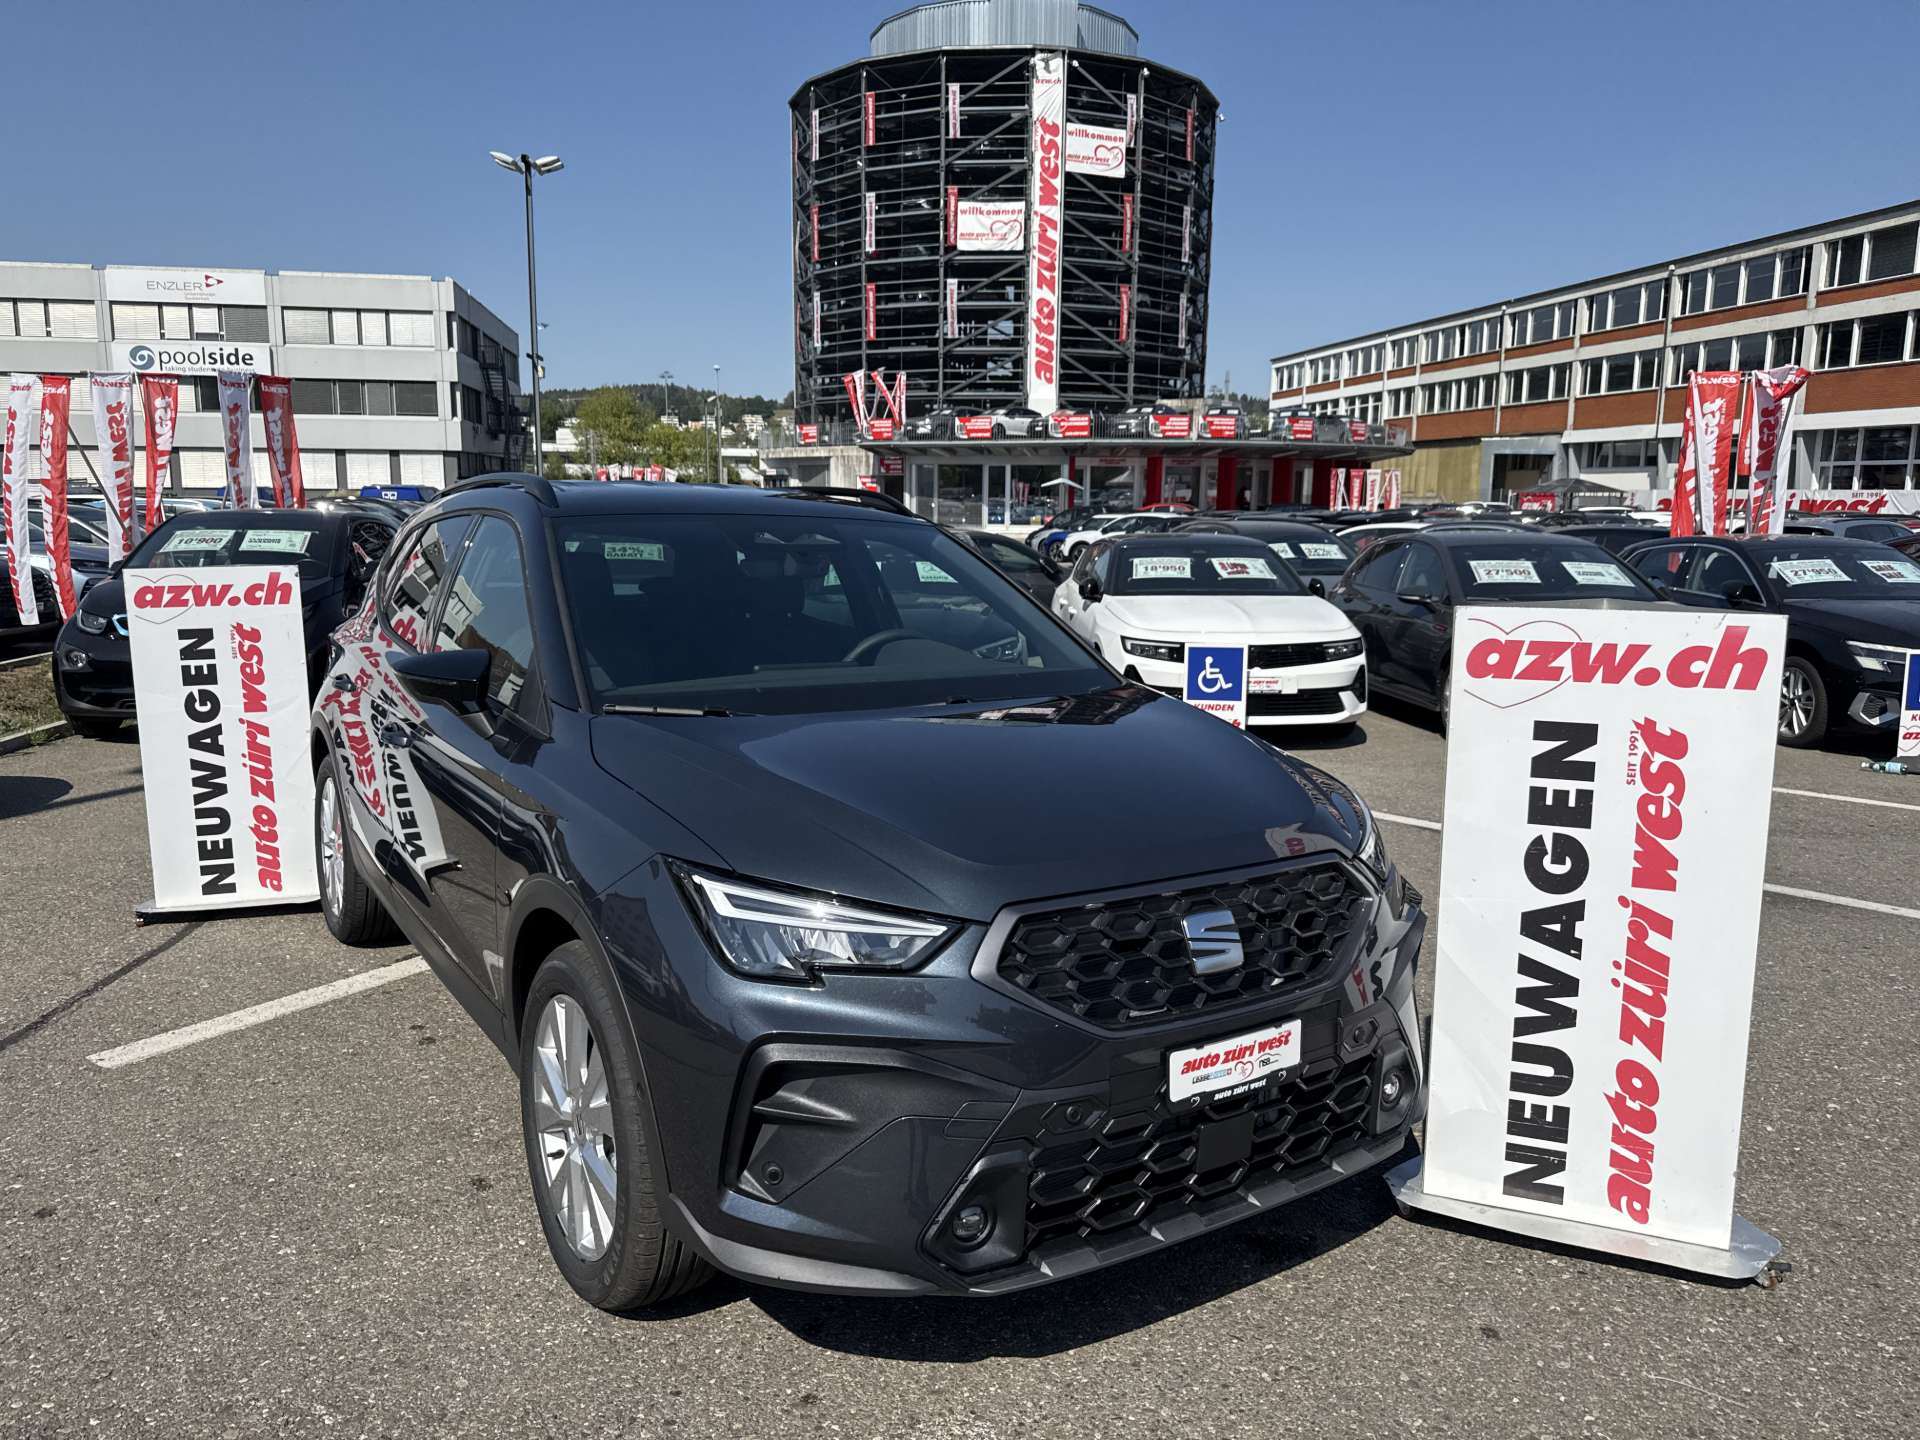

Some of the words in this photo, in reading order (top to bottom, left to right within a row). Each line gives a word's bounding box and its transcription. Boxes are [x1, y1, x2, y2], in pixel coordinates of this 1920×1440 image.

[1038, 116, 1060, 206] west
[1067, 129, 1124, 142] willkommen
[959, 206, 1023, 216] willkommen
[146, 280, 203, 291] ENZLER
[158, 346, 254, 371] poolside
[1033, 298, 1056, 385] auto
[134, 572, 292, 608] azw.ch
[232, 621, 270, 713] west
[1466, 625, 1769, 691] azw.ch
[177, 628, 237, 896] NEUWAGEN
[238, 718, 275, 802] züri
[1626, 761, 1637, 786] SEIT
[1628, 730, 1639, 757] 1991
[1631, 716, 1690, 893] west
[249, 804, 283, 892] auto
[1502, 719, 1599, 1206] NEUWAGEN
[1610, 895, 1676, 1065] züri
[1180, 1052, 1220, 1075] auto
[1220, 1040, 1256, 1064] züri
[1257, 1029, 1292, 1053] west
[1213, 1091, 1232, 1101] auto
[1249, 1078, 1267, 1090] west
[1602, 1058, 1664, 1225] auto
